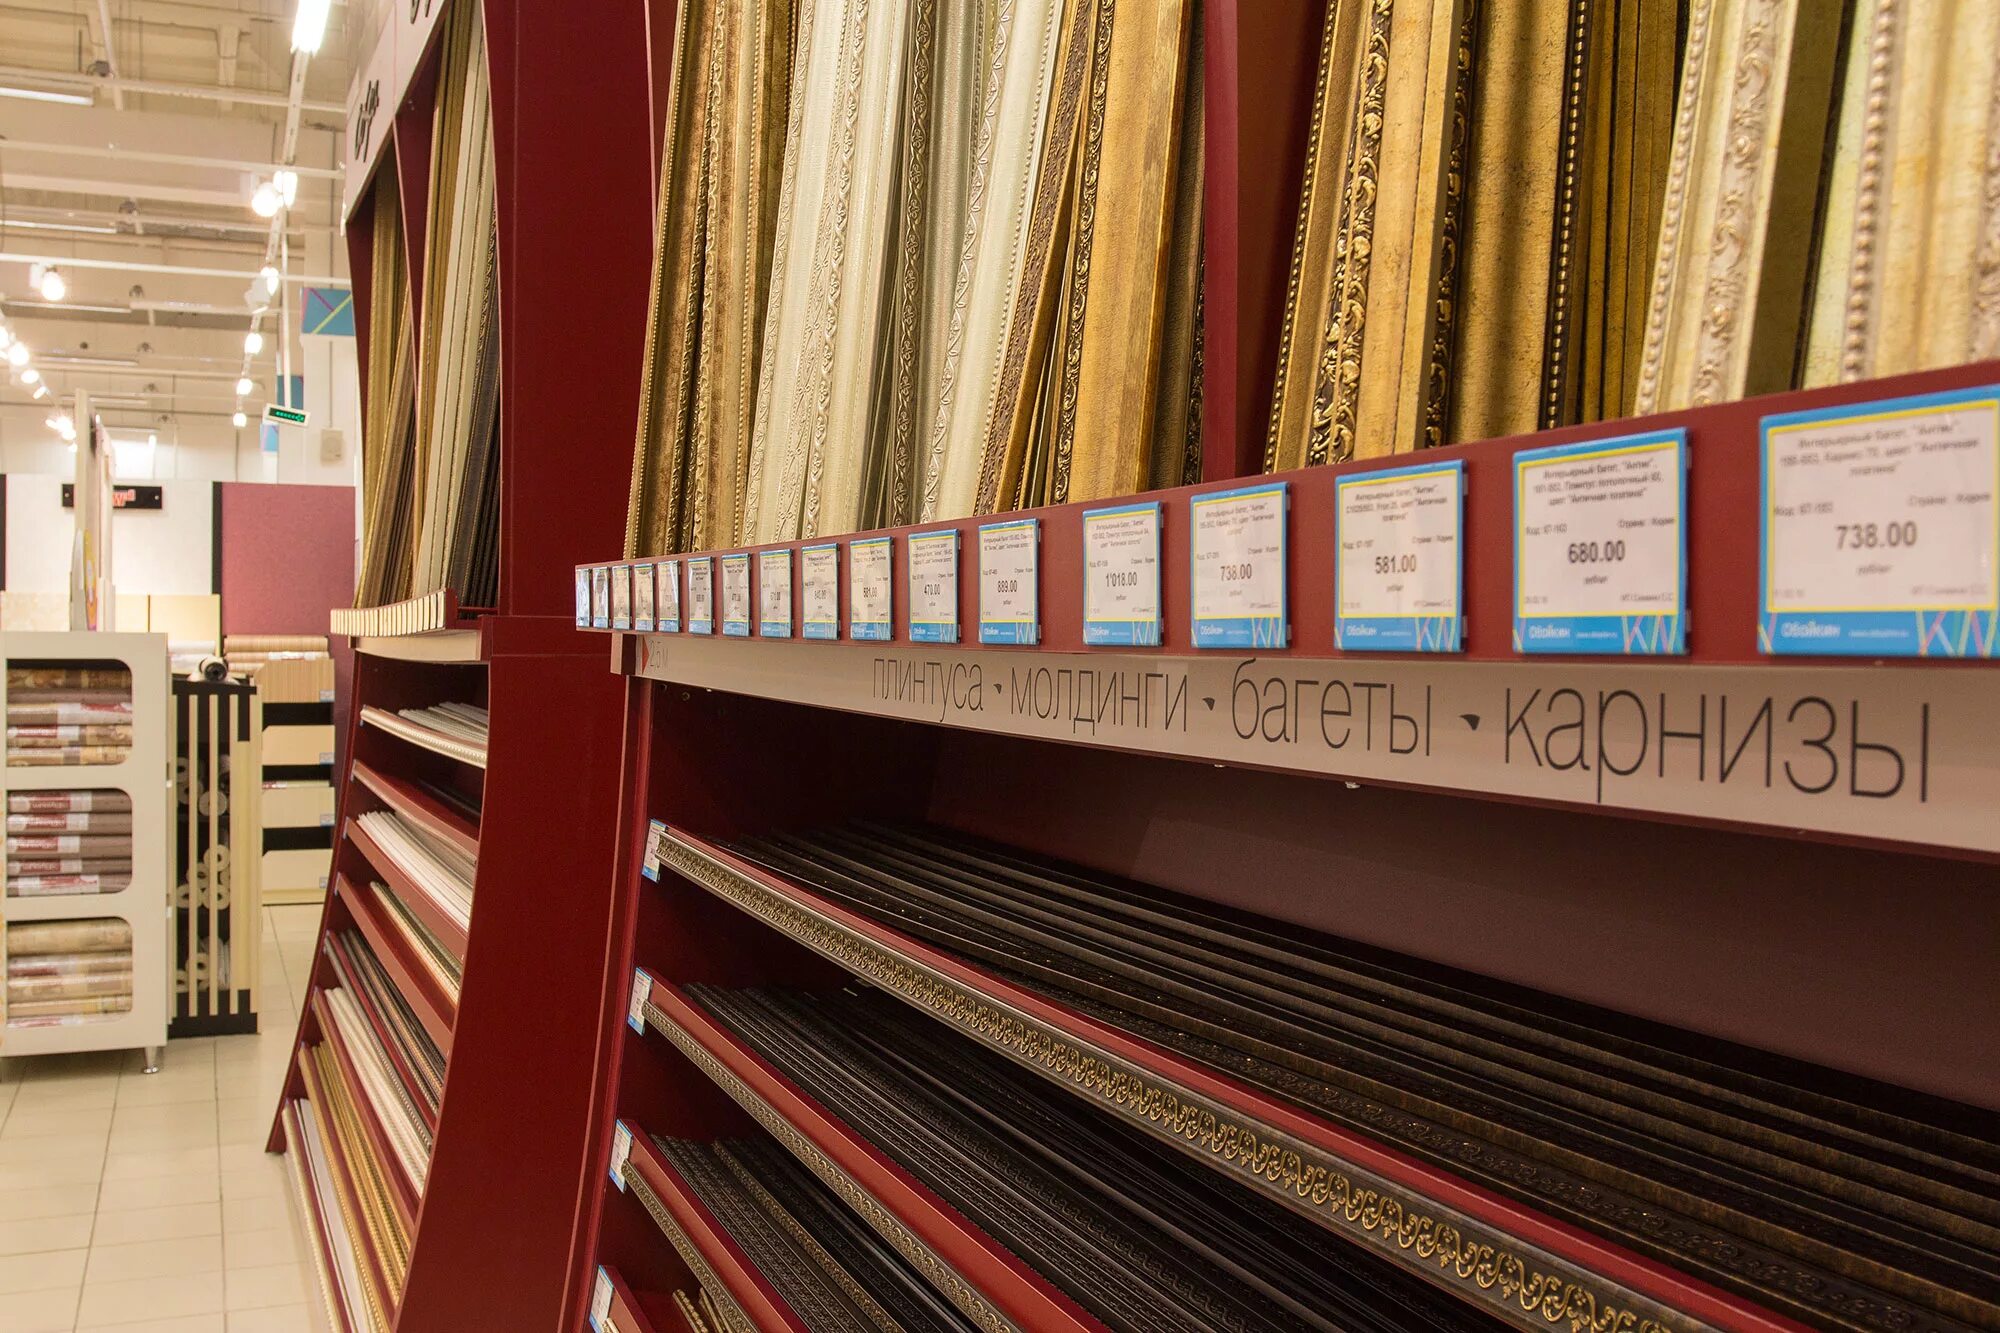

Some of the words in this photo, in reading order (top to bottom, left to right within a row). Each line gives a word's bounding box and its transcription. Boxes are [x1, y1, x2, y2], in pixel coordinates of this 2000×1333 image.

[1834, 520, 1918, 551] 738.00
[1567, 540, 1626, 564] 680.00
[1219, 563, 1253, 581] 738.00
[1375, 554, 1417, 575] 581.00
[1105, 571, 1138, 588] 1'018.00
[872, 658, 985, 722] плинтуса
[1010, 666, 1188, 736] молдинги
[1232, 657, 1432, 757] багеты
[1505, 687, 1931, 803] карнизы
